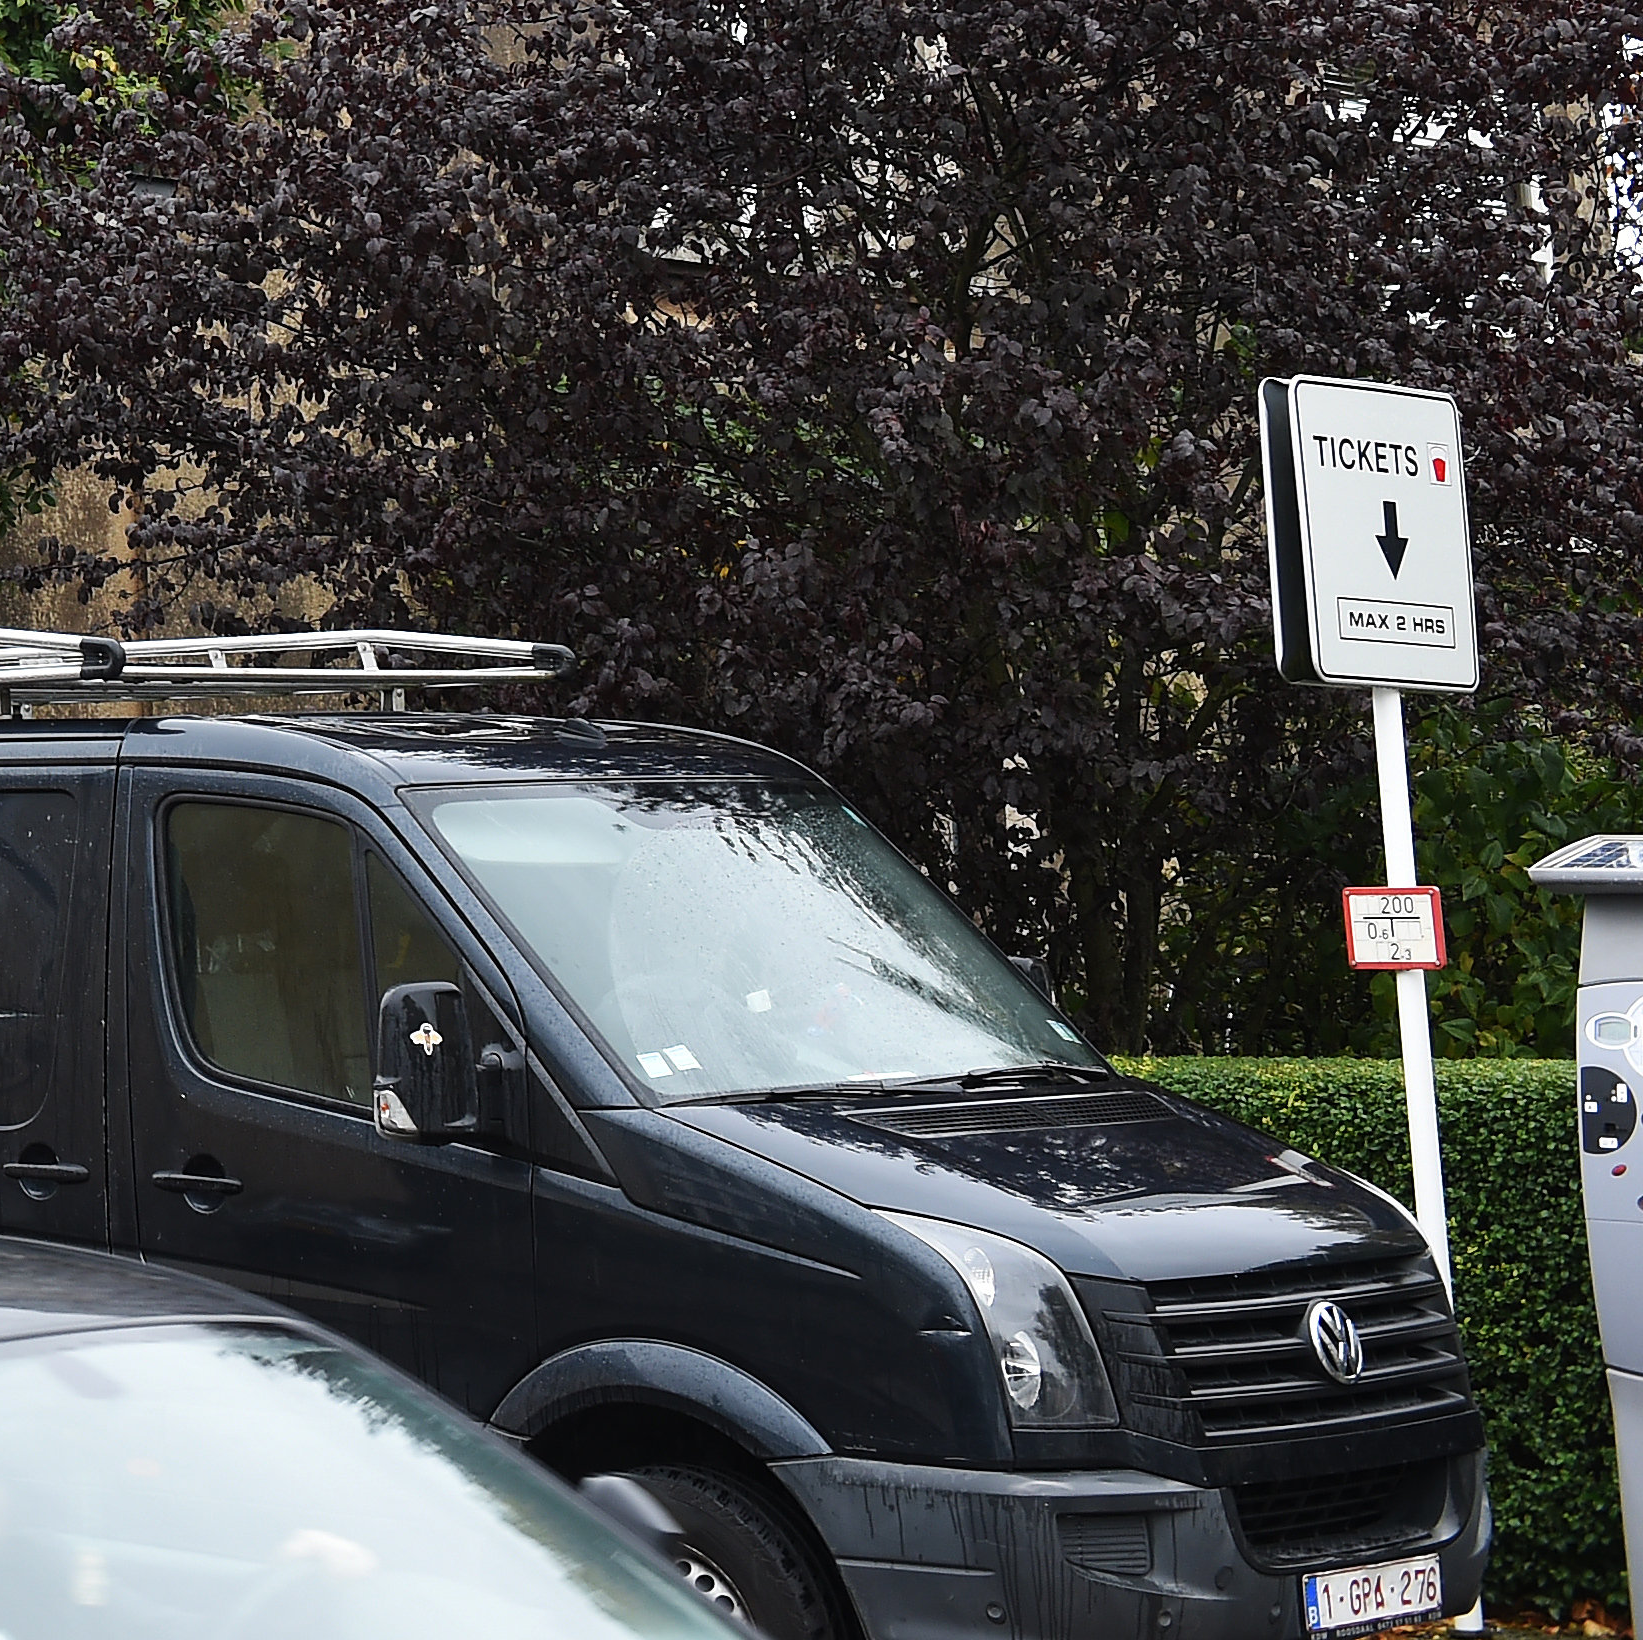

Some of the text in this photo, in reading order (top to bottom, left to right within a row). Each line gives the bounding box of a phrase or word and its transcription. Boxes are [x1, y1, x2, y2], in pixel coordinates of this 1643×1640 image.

[1313, 435, 1418, 476] TICKETS
[1349, 612, 1445, 634] MAX 2 HRS
[1380, 896, 1414, 914] 200
[1308, 1606, 1318, 1624] B
